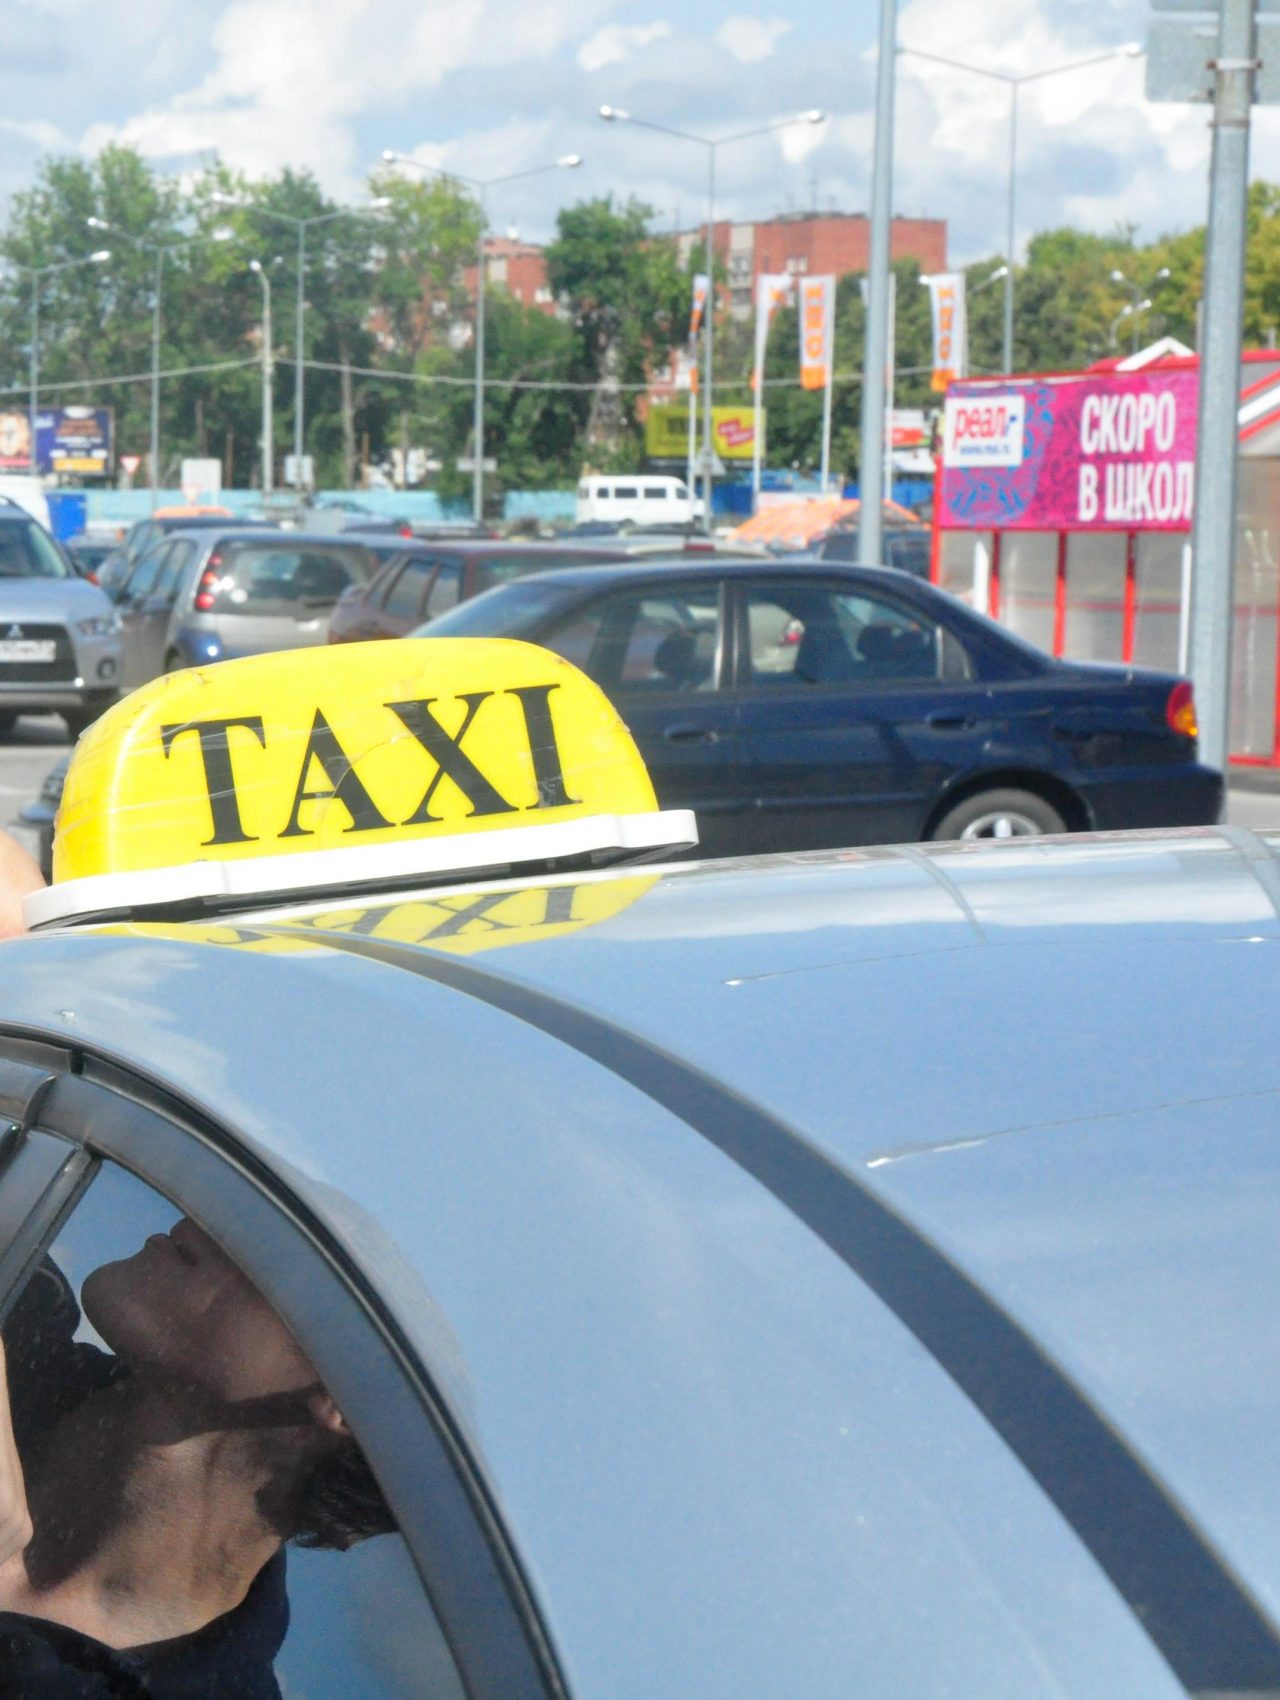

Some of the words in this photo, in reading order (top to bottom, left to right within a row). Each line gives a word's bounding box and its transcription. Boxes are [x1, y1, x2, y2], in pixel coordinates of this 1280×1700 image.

[1080, 391, 1176, 454] СКОРО
[1078, 463, 1099, 522] В
[162, 684, 582, 846] TAXI
